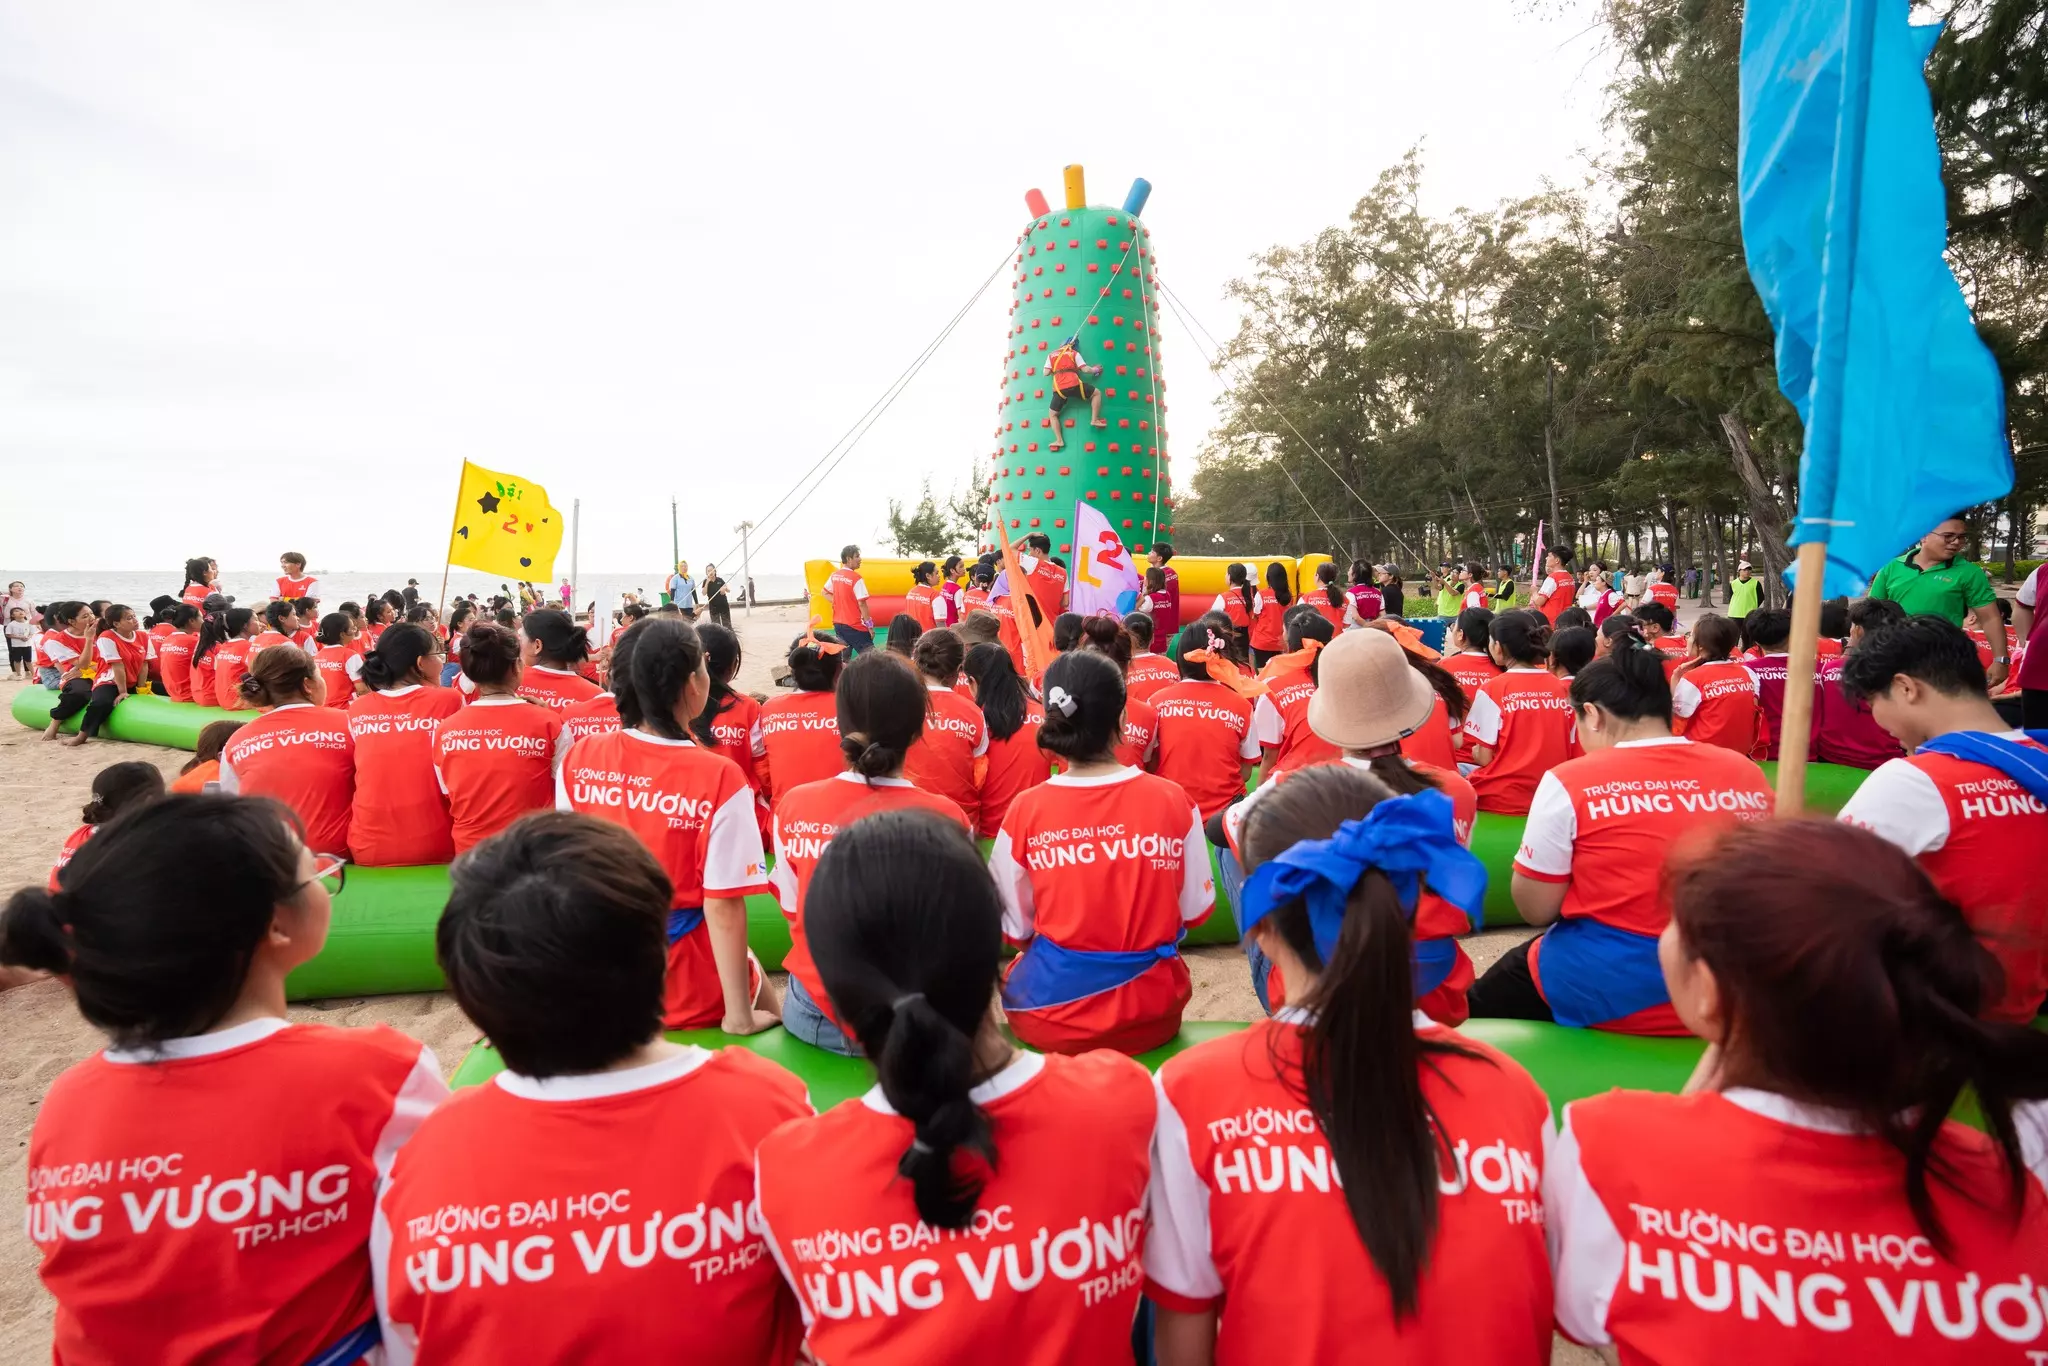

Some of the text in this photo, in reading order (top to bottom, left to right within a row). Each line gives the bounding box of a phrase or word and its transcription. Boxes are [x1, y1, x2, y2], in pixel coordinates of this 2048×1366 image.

[502, 513, 519, 535] 2
[1096, 531, 1124, 572] 2
[352, 719, 391, 738] HÙNG
[393, 712, 412, 720] HỌC
[762, 720, 798, 737] HÙNG
[926, 717, 977, 735] VƯƠNG
[1198, 708, 1245, 727] VƯƠNG
[276, 728, 296, 736] HỌC
[314, 742, 346, 750] TP.HCM
[483, 728, 502, 736] HỌC
[485, 735, 547, 751] VƯƠNG
[232, 730, 346, 766] HÙNG VƯƠNG
[627, 775, 652, 788] HỌC
[1583, 779, 1700, 797] TRƯỜNG ĐẠI HỌC
[1955, 779, 2017, 795] TRƯỜNG
[573, 779, 713, 820] ÙNG VƯƠNG
[1587, 788, 1768, 820] HÙNG VƯƠNG
[1960, 791, 2047, 819] HÙNG
[783, 833, 832, 859] HÙN
[1027, 824, 1125, 848] RƯỜNG ĐẠI HỌC
[1026, 832, 1183, 871] HÙNG VƯƠNG
[1207, 1106, 1316, 1144] TRƯỜNG
[72, 1160, 113, 1190] ĐẠI
[118, 1153, 183, 1183] HỌC
[1213, 1136, 1345, 1195] HÙN
[121, 1164, 351, 1235] VƯƠNG
[233, 1202, 348, 1250] TP.HCM
[406, 1189, 631, 1242] TRƯỜNG ĐẠI HỌC
[791, 1228, 882, 1263] TRƯỜNG
[888, 1223, 941, 1252] ĐẠI
[1629, 1203, 1936, 1271] TRƯỜNG ĐẠI HỌC
[405, 1234, 554, 1295] HÙNG
[956, 1208, 1145, 1301] VƯƠNG
[1627, 1239, 1853, 1333] HÙNG
